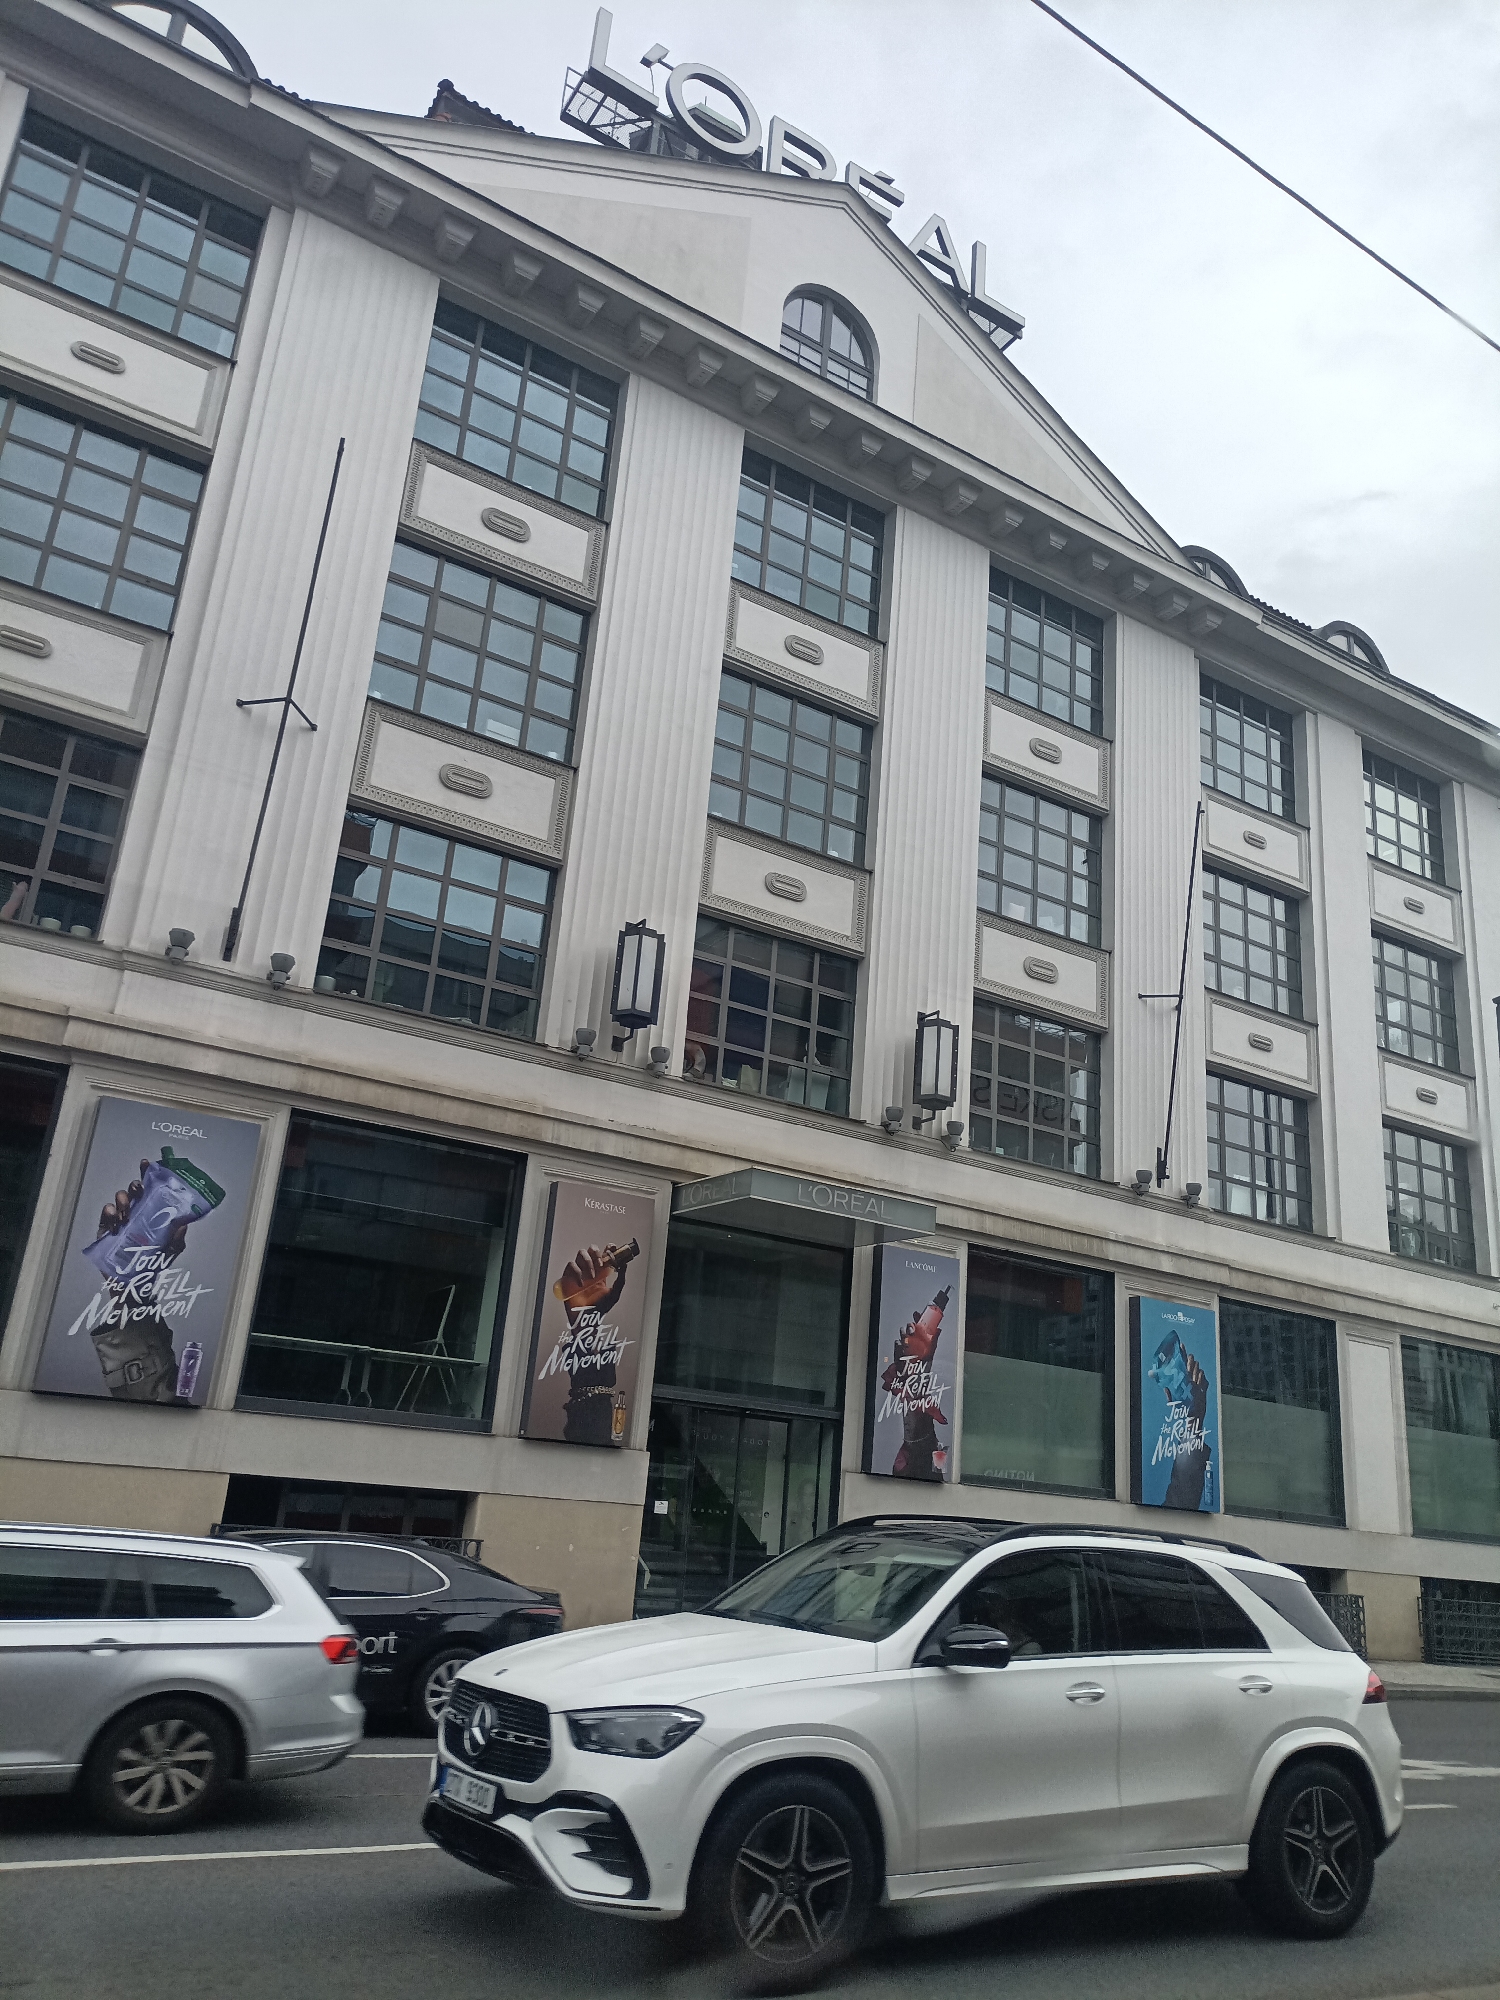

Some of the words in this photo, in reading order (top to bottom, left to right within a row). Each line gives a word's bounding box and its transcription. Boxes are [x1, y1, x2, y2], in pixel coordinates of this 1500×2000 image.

[798, 1183, 893, 1220] L'ORÉAL
[101, 1276, 125, 1293] the
[558, 1331, 574, 1344] the
[890, 1377, 904, 1390] the
[1160, 1422, 1172, 1435] the
